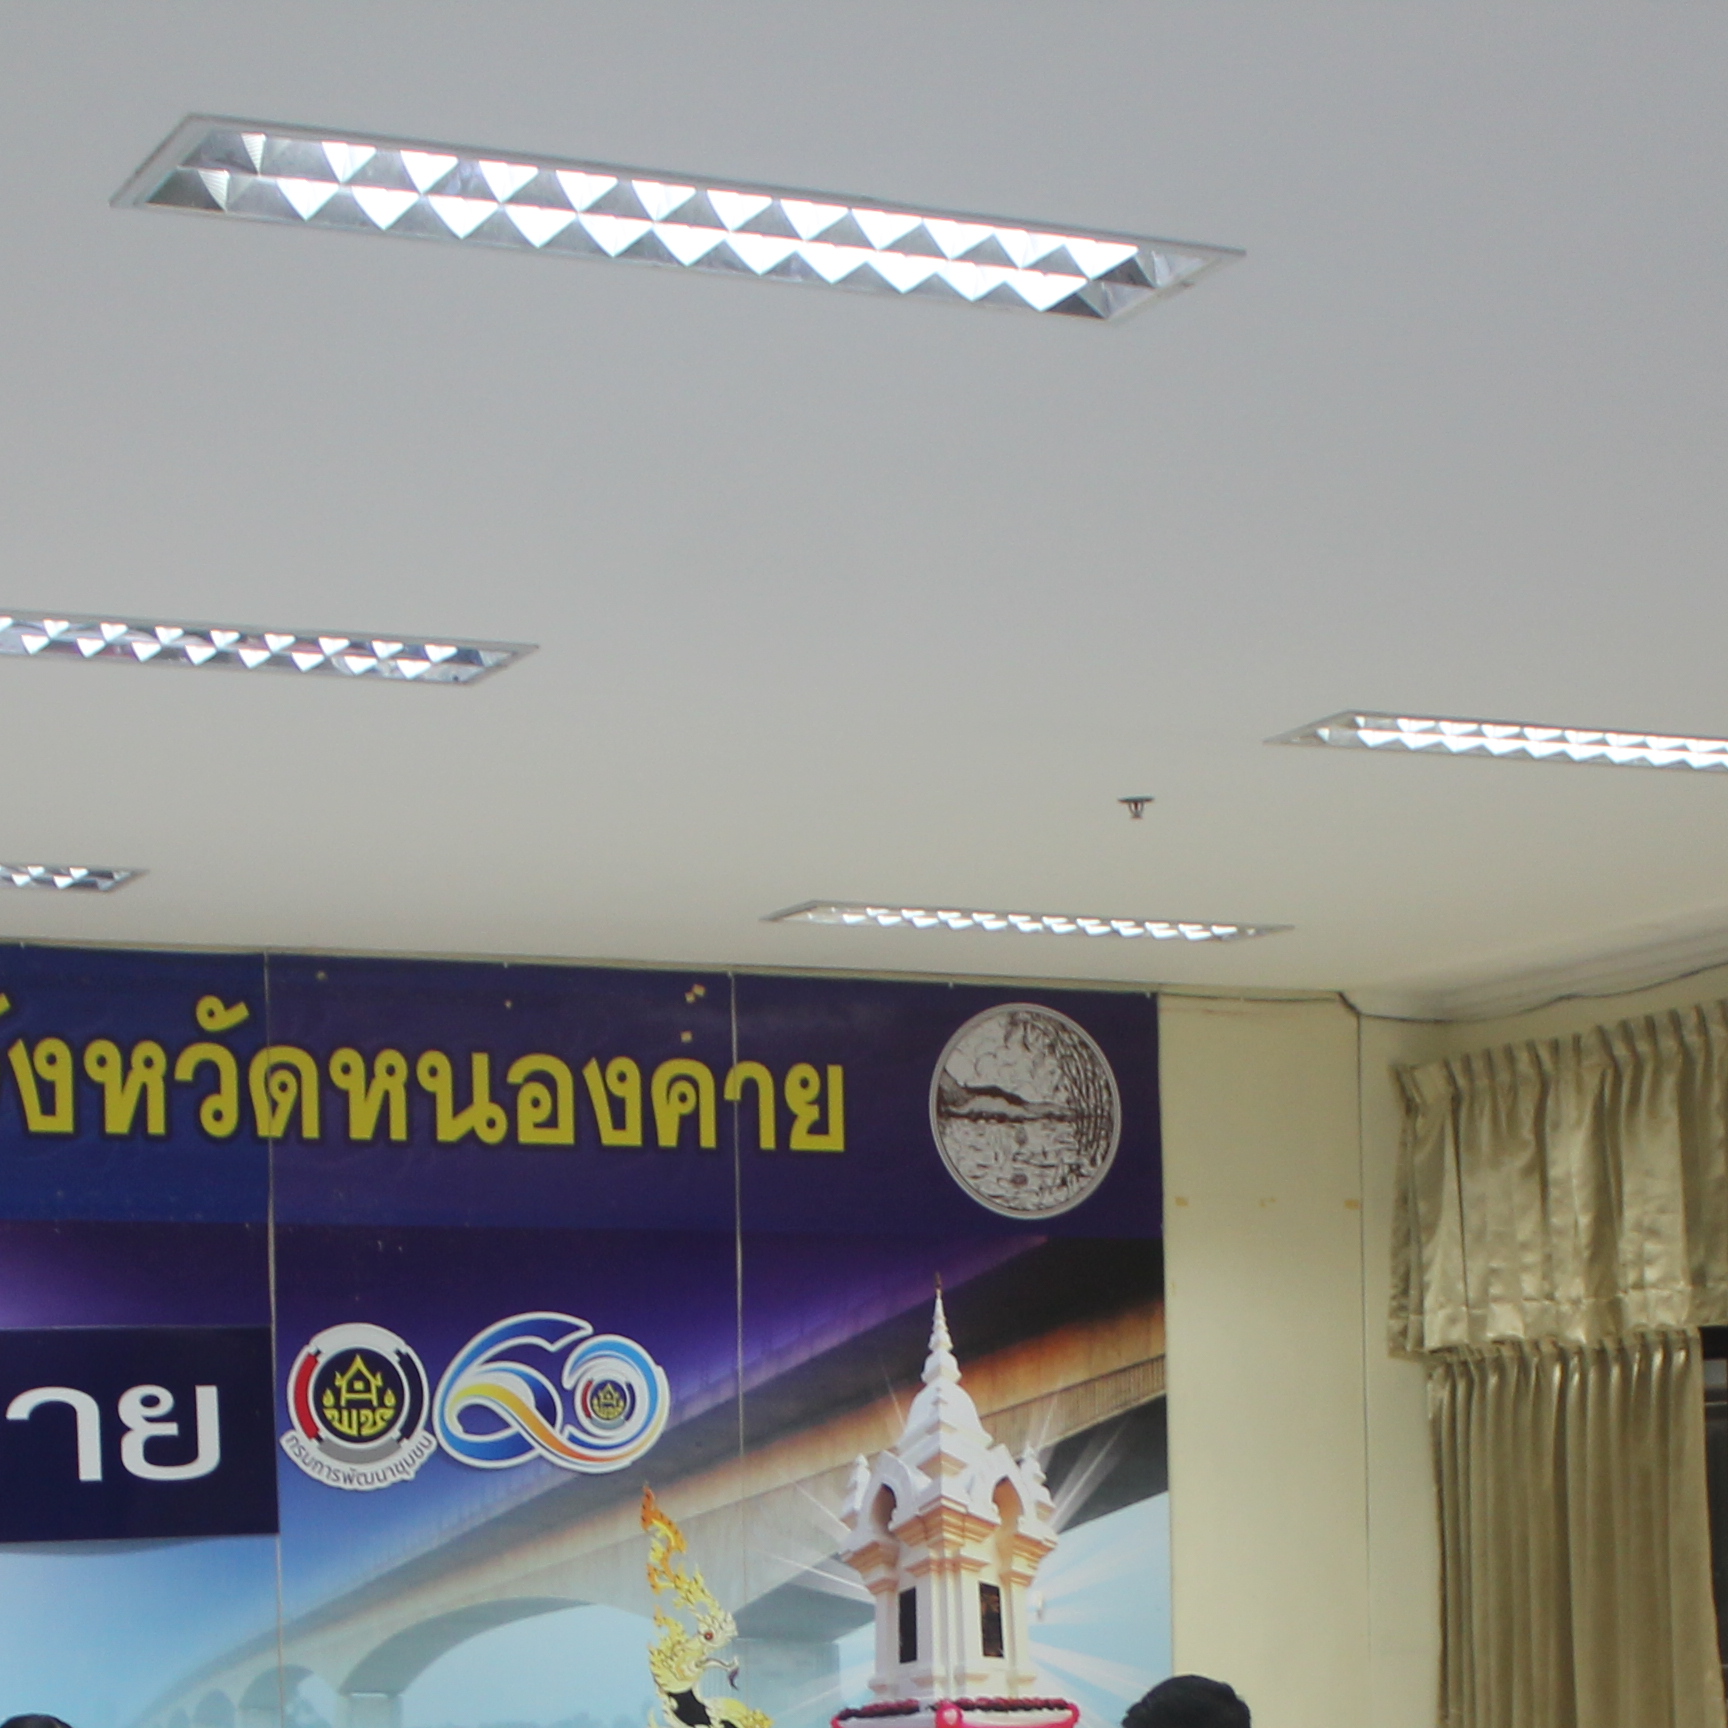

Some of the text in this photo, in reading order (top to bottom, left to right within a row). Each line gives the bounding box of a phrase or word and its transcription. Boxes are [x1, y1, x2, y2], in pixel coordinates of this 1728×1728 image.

[284, 1433, 434, 1487] กรมการพัฒนาชุมชน
